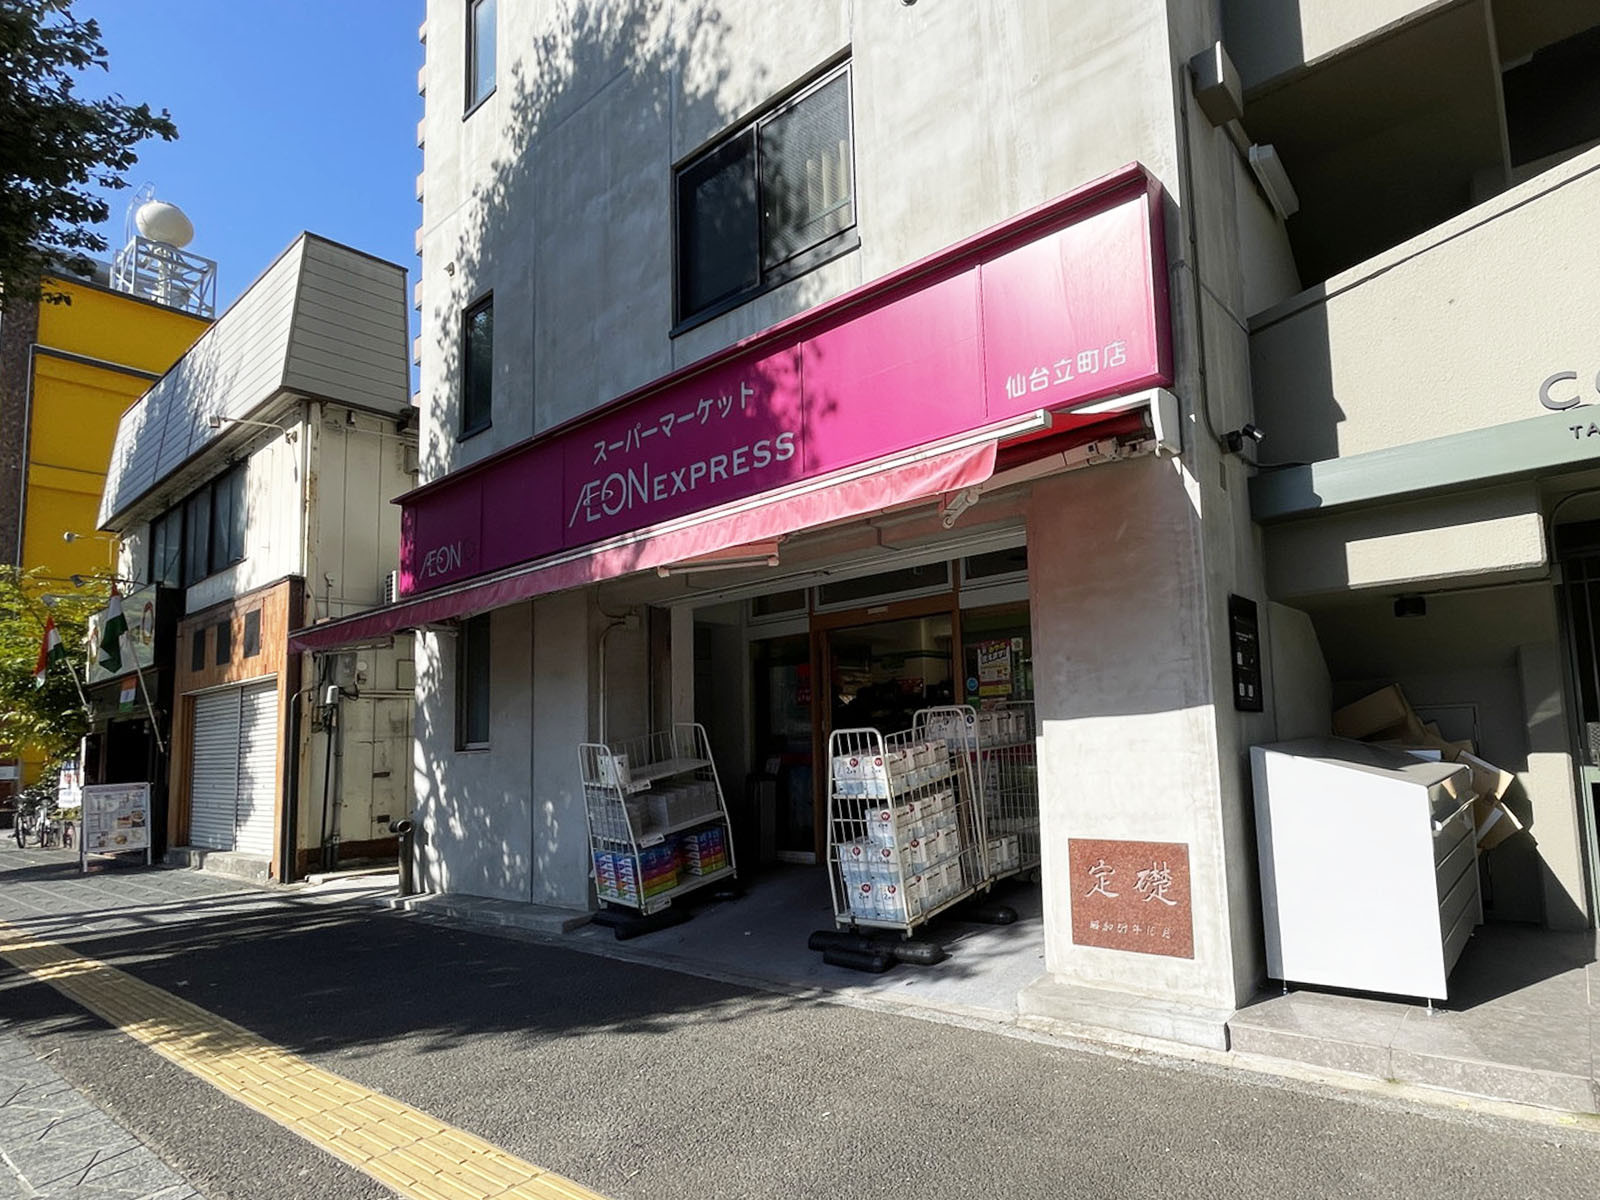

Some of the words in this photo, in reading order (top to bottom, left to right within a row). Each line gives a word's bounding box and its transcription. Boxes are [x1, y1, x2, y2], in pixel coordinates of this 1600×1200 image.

[1005, 340, 1127, 400] 仙台立町店
[1539, 371, 1600, 411] C
[593, 381, 754, 465] スーパーマーケット
[654, 432, 795, 501] EXPRESS
[1084, 860, 1177, 906] 定礎
